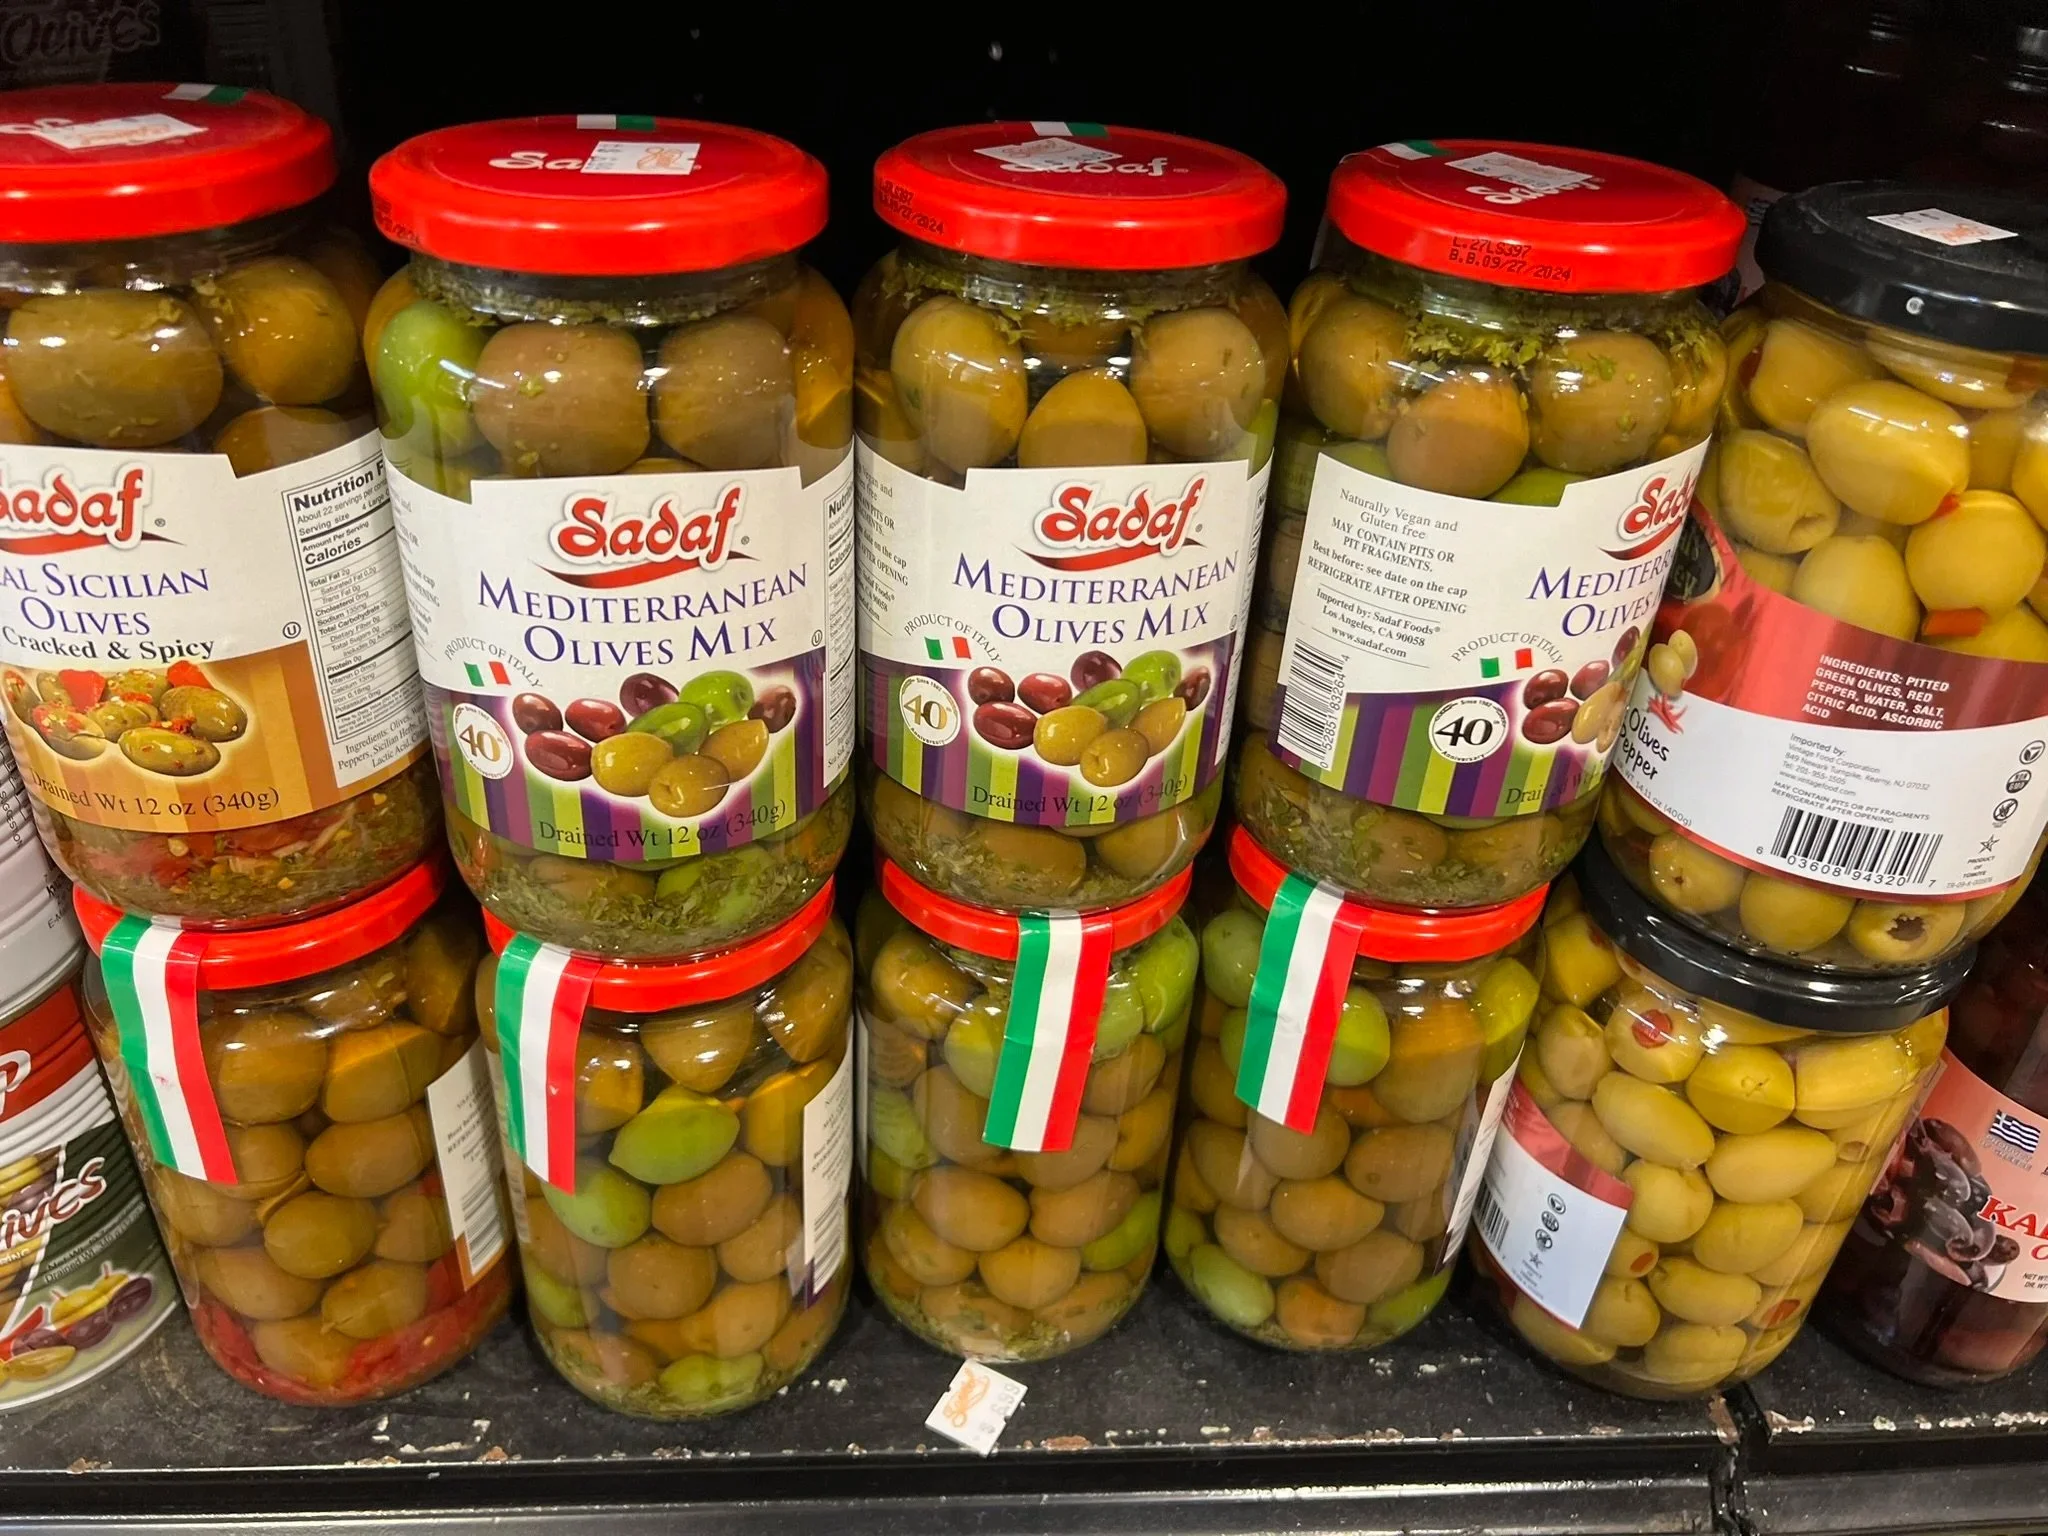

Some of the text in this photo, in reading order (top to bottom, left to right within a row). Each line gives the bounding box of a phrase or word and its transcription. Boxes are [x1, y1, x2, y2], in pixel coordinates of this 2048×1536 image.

[1449, 248, 1571, 282] B.B.09/27/2024
[294, 472, 374, 512] Nutrition
[297, 511, 322, 525] About
[322, 507, 334, 518] 22
[335, 494, 363, 511] servings
[363, 488, 374, 499] per
[880, 482, 894, 499] and
[1339, 488, 1459, 533] Naturally Vegan and
[1623, 470, 1698, 535] Sad
[299, 519, 332, 537] Serving
[335, 512, 350, 524] size
[368, 493, 385, 508] Large
[556, 486, 741, 565] Sadaf
[884, 516, 896, 532] OR
[1040, 477, 1205, 550] Sadaf
[1360, 511, 1427, 540] Gluten free
[302, 520, 370, 553] Amount Per Serving
[305, 536, 361, 566] Calories
[1331, 516, 1456, 564] MAY CONTAIN PITS OR
[1343, 535, 1434, 573] PIT FRAGMENTS.
[877, 562, 909, 587] OPENING
[882, 545, 907, 571] the cap
[951, 550, 1240, 605] MEDITERRANEAN
[1312, 539, 1468, 599] Best before: see date on the cap
[1526, 547, 1672, 601] MEDITERR
[42, 562, 210, 599] SICILIAN
[309, 577, 327, 589] Total
[328, 572, 341, 582] Fat
[477, 563, 808, 625] MEDITERRANEAN
[1307, 555, 1468, 615] REFRIGERATE AFTER OPENING
[20, 596, 151, 636] OLIVES
[315, 597, 355, 617] Cholesterol
[991, 601, 1210, 645] OLIVES MIX
[1316, 588, 1403, 629] Imported by: Sadaf
[1322, 605, 1426, 648] Los Angeles, CA 90058
[1561, 591, 1653, 637] OLIVES
[2, 626, 214, 661] Cracked & Spicy
[524, 617, 778, 667] OLIVES MIX
[904, 613, 1002, 662] PRODUCT OF ITALY
[1331, 626, 1407, 659] www.sadaf.com
[1450, 632, 1564, 664] PRODUCT OF ITALY
[326, 660, 353, 673] Protein
[443, 636, 544, 689] PRODUCT OF ITALY
[1819, 654, 1950, 693] INGREDIENTS: PITTED
[1810, 678, 1945, 719] PEPPER, WATER, SALT,
[1815, 666, 1934, 704] GREEN OLIVES, RED
[903, 694, 949, 730] 40
[1801, 702, 1832, 720] ACID
[1806, 690, 1945, 731] CITRIC ACID, ASCORBIC
[345, 727, 388, 755] Ingredients:
[458, 723, 501, 763] 40
[1321, 713, 1338, 752] 52851
[1434, 715, 1494, 747] 40
[1619, 722, 1659, 780] Pepper
[1629, 707, 1670, 762] Olives
[1789, 732, 1847, 758] Imported by:
[338, 748, 372, 770] Peppers,
[372, 734, 399, 756] Sicilian
[1782, 760, 1794, 771] Tel:
[1784, 751, 1932, 792] 849 Newark Turnpike, Kearny, NJ 07032
[1788, 743, 1881, 775] Vintage Food Corporation
[29, 767, 280, 817] Drained Wt 12 oz (340g)
[972, 784, 1047, 814] Drained
[1054, 795, 1081, 814] Wt
[1088, 794, 1109, 813] 12
[1137, 773, 1189, 808] (340g)
[1773, 780, 1931, 822] MAY CONTAIN PITS OR PIT FRAGMENTS
[1779, 769, 1857, 797] www.vintagefood.com
[1635, 780, 1693, 827] 14.11 oz (400g)
[1770, 786, 1895, 824] REFRIGERATE AFTER OPENING
[538, 799, 788, 849] Drained Wt 12 oz (340g)
[1755, 846, 1764, 856] 6
[1787, 854, 1843, 878] 03608
[1851, 869, 1907, 888] 94320
[1928, 878, 1937, 888] 7
[1967, 855, 1996, 864] PRODUCT
[2, 1157, 107, 1251] ives
